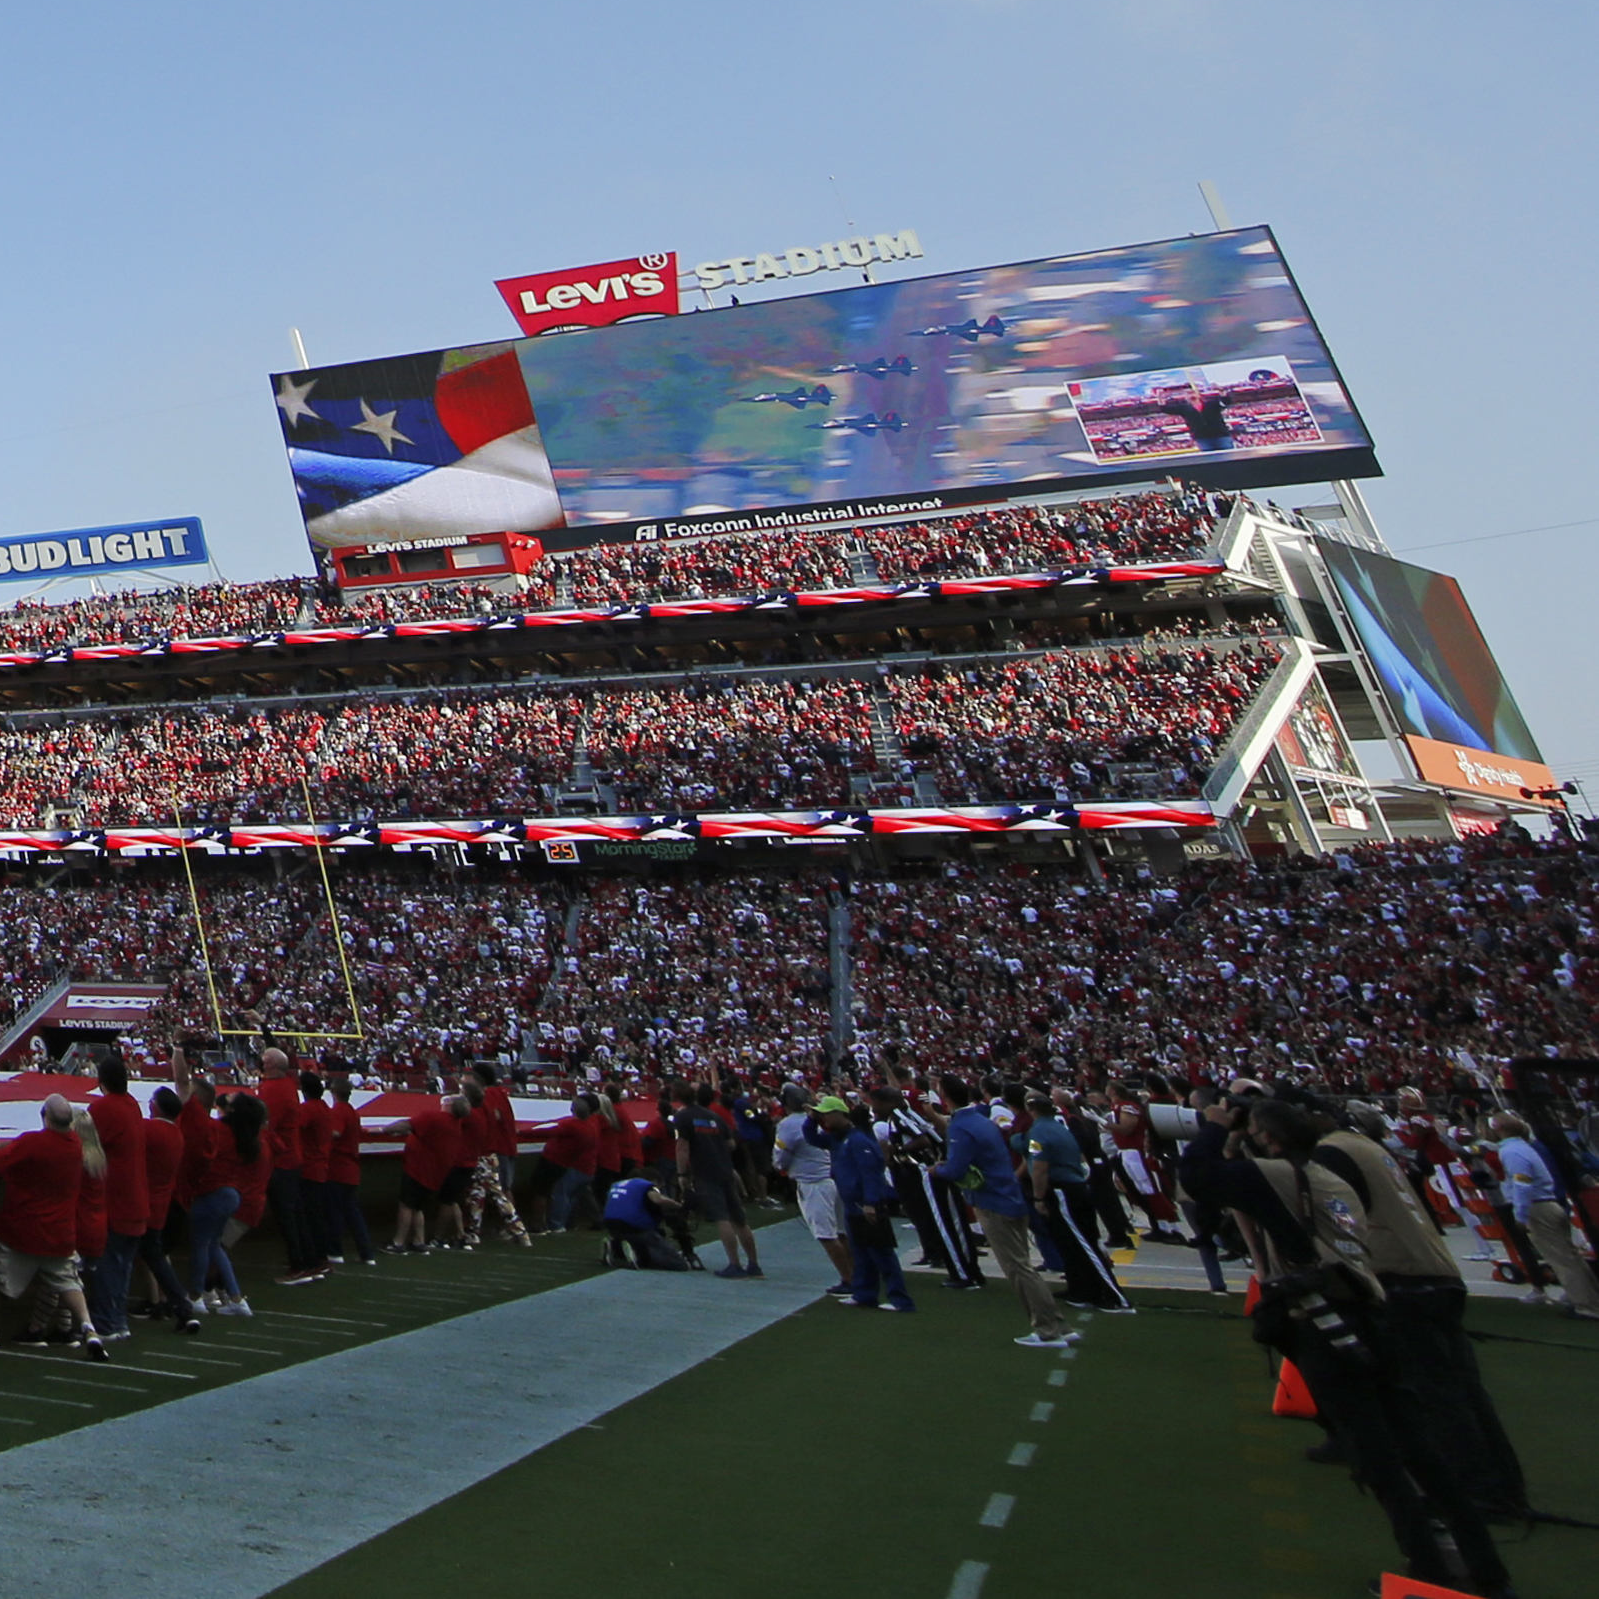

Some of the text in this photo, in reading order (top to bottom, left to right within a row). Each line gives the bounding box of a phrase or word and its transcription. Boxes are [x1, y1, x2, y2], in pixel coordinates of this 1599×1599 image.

[695, 229, 923, 290] STADIUM
[664, 518, 752, 538] Foxconn
[754, 504, 854, 528] Industrial
[859, 497, 943, 518] Internet
[414, 535, 468, 550] STADIUM
[550, 843, 576, 859] 25
[594, 841, 691, 859] MorningStar
